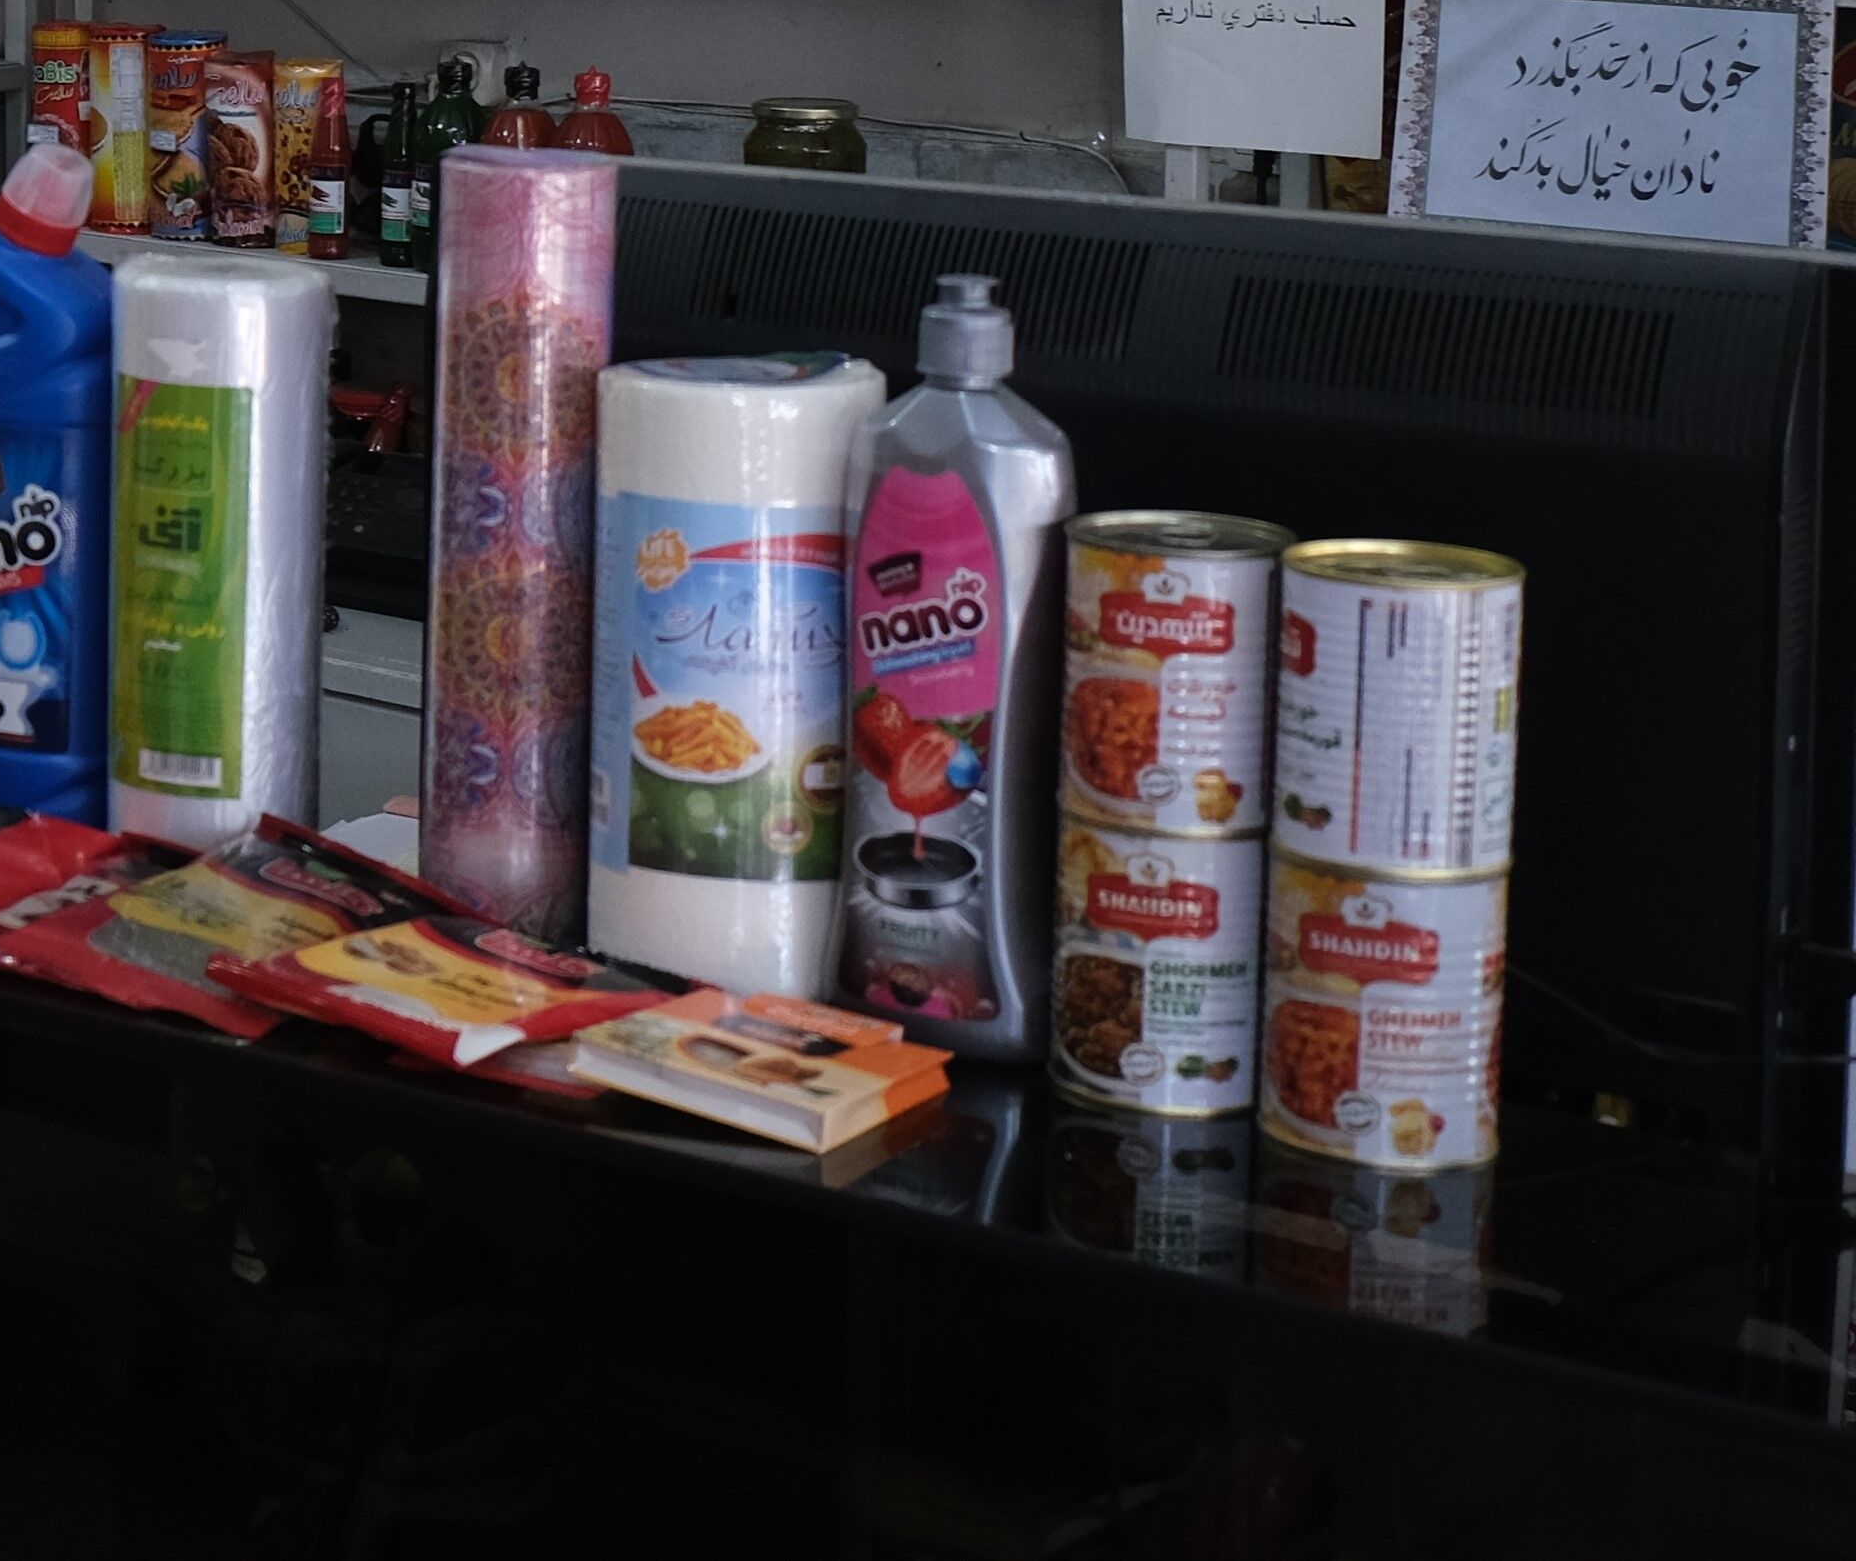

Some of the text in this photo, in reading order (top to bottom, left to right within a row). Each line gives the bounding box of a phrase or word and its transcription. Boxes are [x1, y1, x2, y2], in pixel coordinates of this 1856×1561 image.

[1293, 5, 1356, 31] حساب
[863, 597, 983, 651] nano
[1096, 889, 1203, 920] SHAHDIN
[1309, 932, 1422, 965] SHAHDIN
